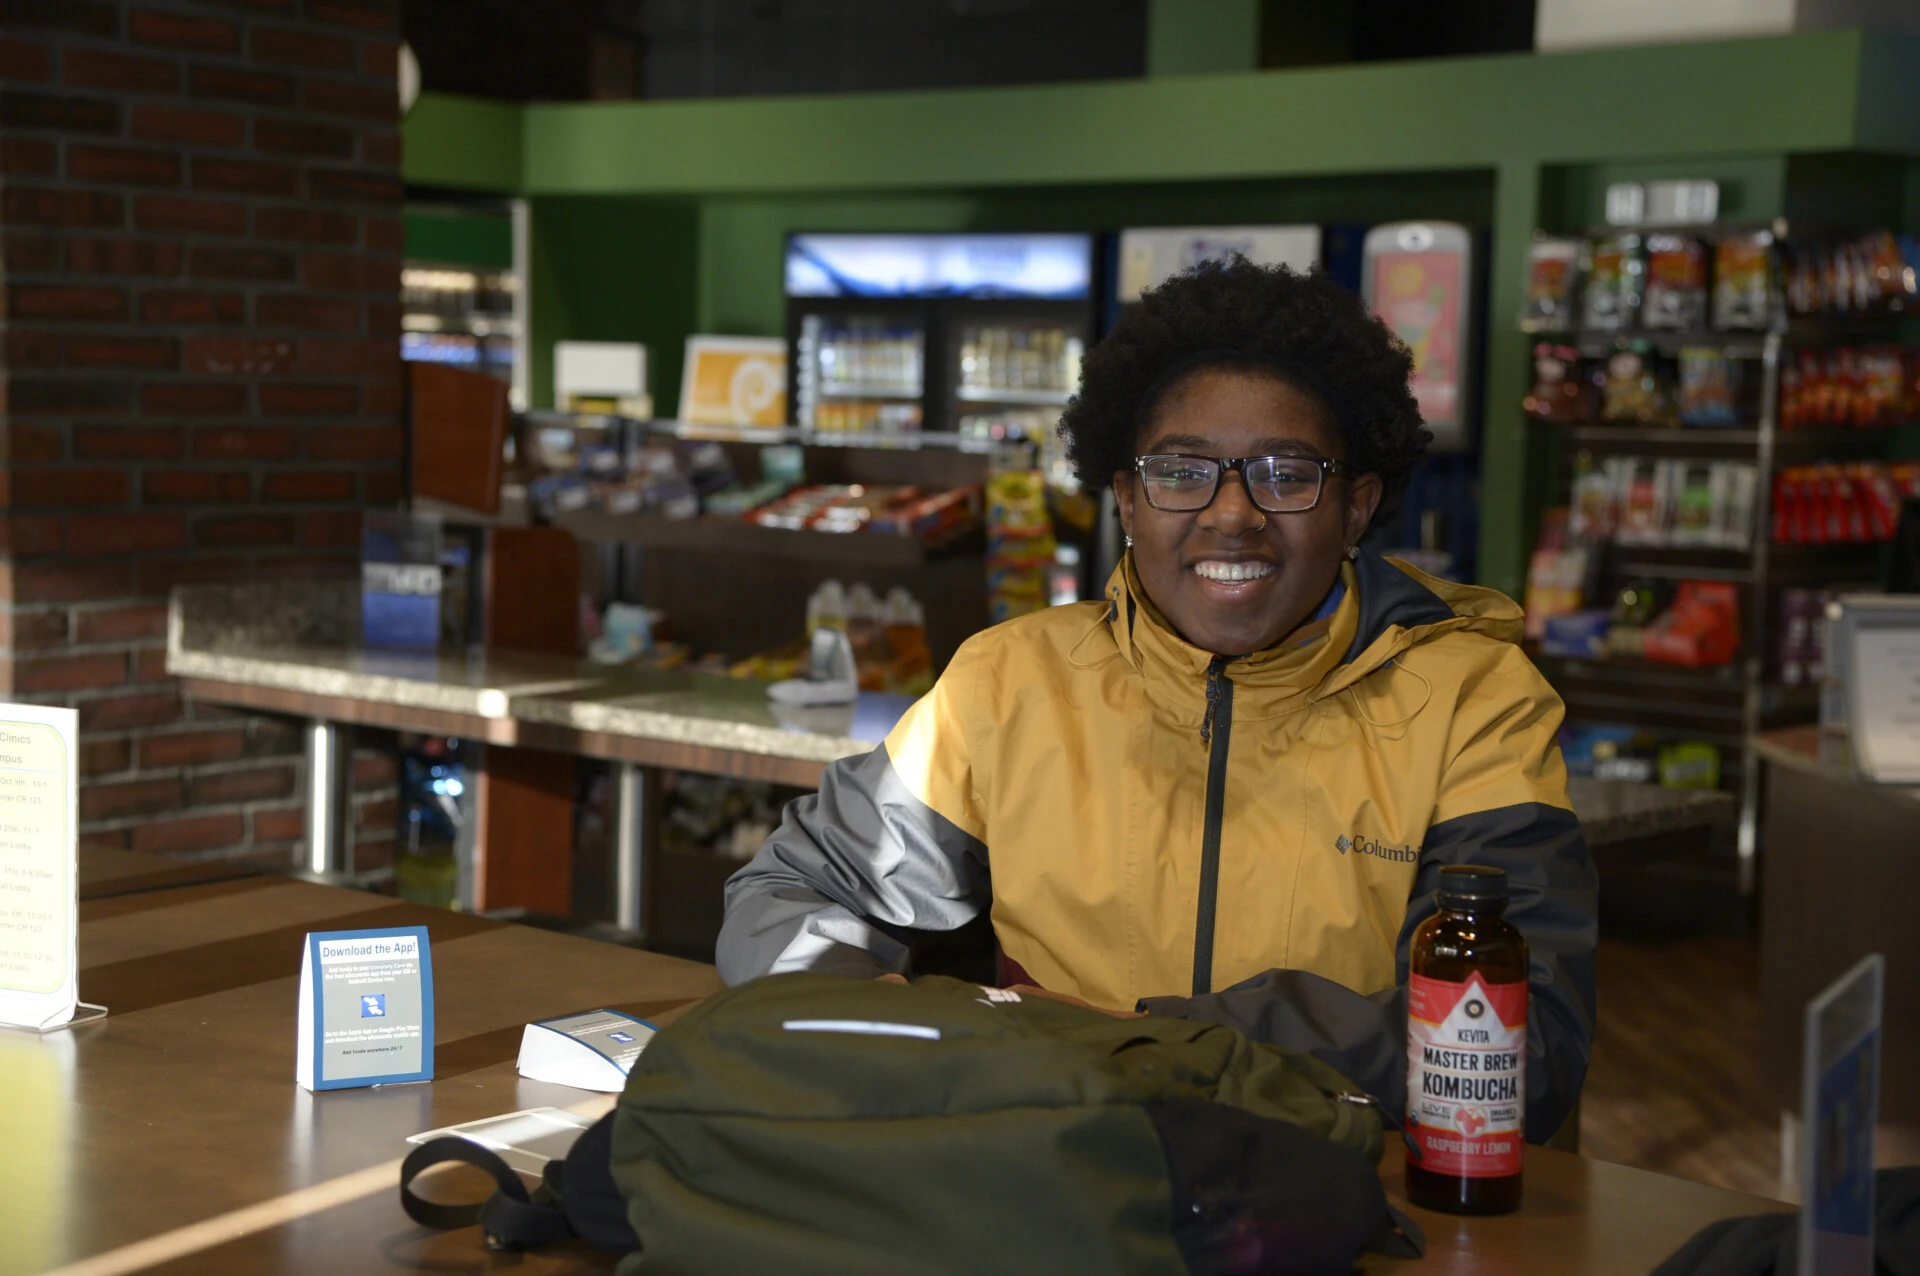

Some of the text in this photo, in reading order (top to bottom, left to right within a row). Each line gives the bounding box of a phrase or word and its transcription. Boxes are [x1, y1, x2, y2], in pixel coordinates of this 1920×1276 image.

[0, 731, 31, 744] Clinics
[16, 795, 27, 804] CR
[29, 796, 41, 805] 123
[11, 841, 31, 852] Lobby
[323, 942, 416, 957] Download the App!
[391, 969, 402, 977] your
[335, 1035, 358, 1043] download
[1458, 1029, 1490, 1044] KEVITA
[366, 1047, 389, 1055] anywhere
[1424, 1047, 1518, 1072] MASTER BREW
[1423, 1070, 1518, 1101] KOMBUCHA
[1422, 1102, 1450, 1116] LIVE
[1427, 1136, 1512, 1156] RASPBERRY LEMON
